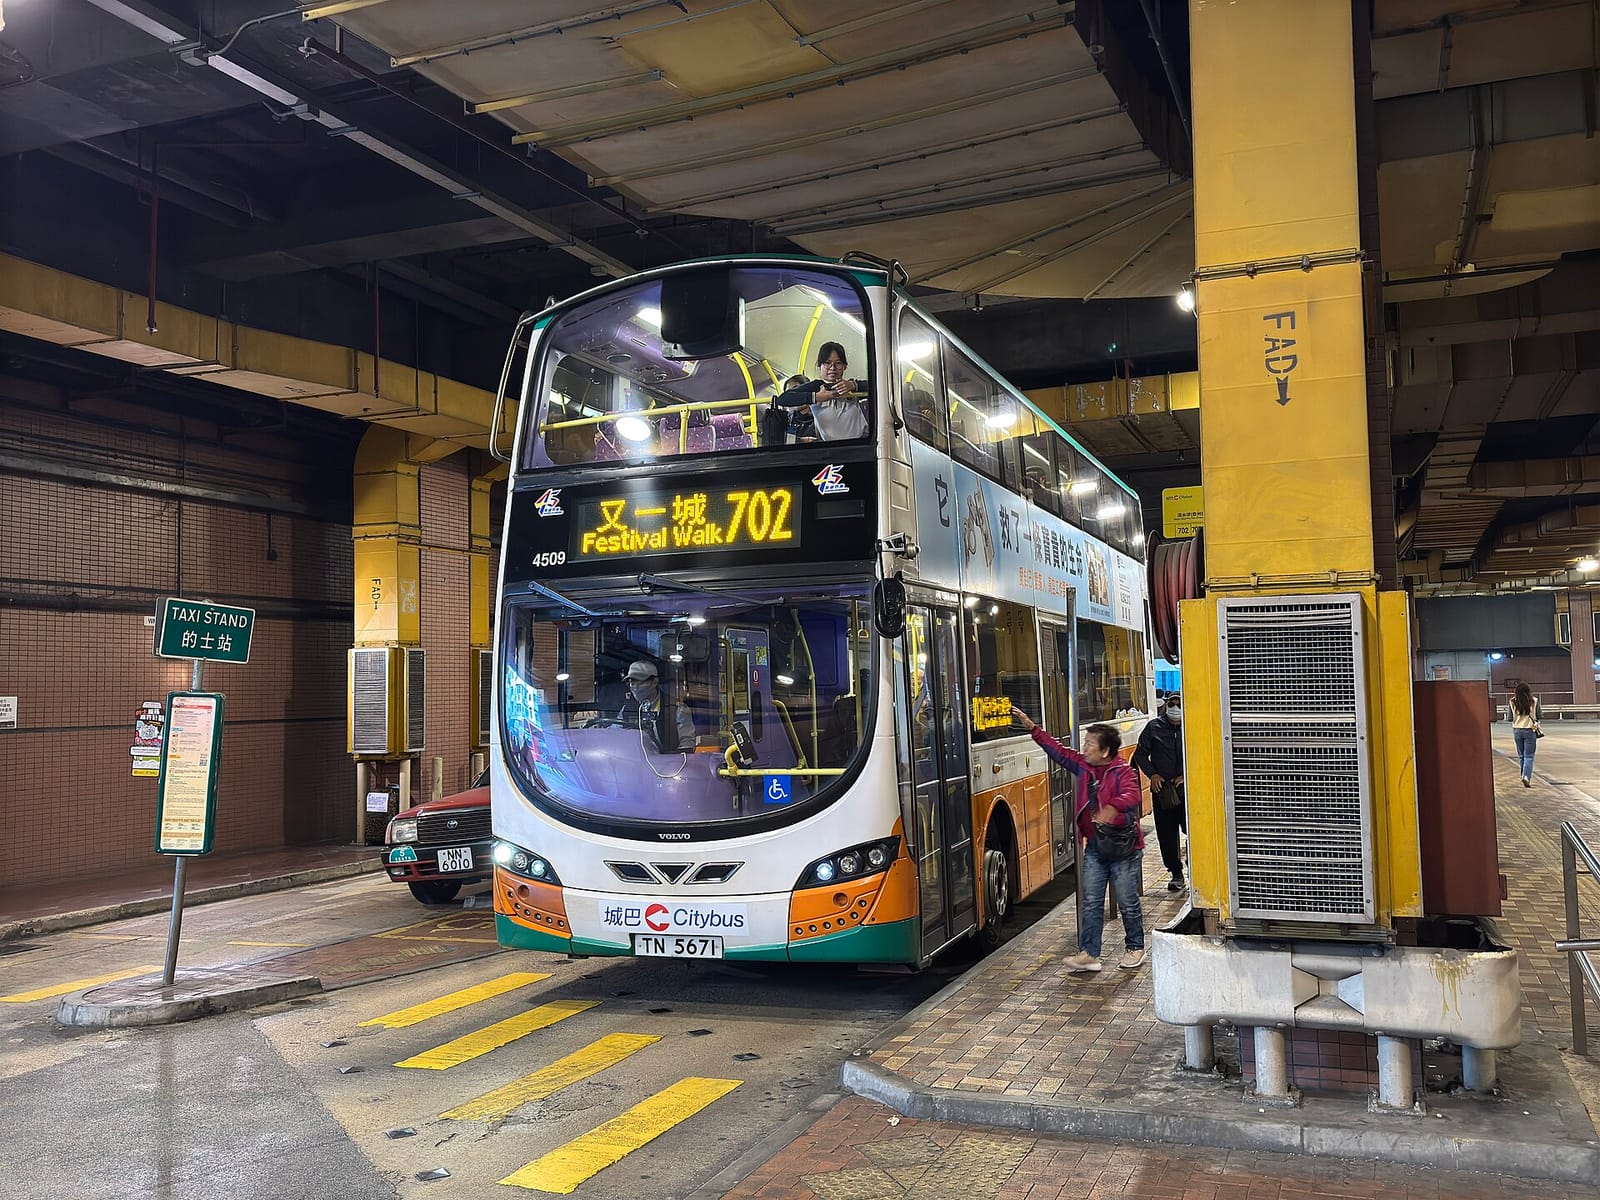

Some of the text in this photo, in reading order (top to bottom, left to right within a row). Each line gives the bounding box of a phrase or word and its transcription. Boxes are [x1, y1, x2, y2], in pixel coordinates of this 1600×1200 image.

[935, 474, 950, 528] 它
[596, 493, 707, 533] 又一城
[726, 489, 792, 543] 702
[582, 523, 723, 554] Festival Walk
[532, 551, 566, 567] 4509
[172, 607, 248, 628] TAXI STAND
[181, 630, 233, 652] 的士站
[442, 859, 470, 871] 6010
[447, 849, 462, 860] NN
[603, 906, 641, 927] 城巴
[673, 909, 744, 929] Citybus
[642, 938, 716, 956] TN 5671
